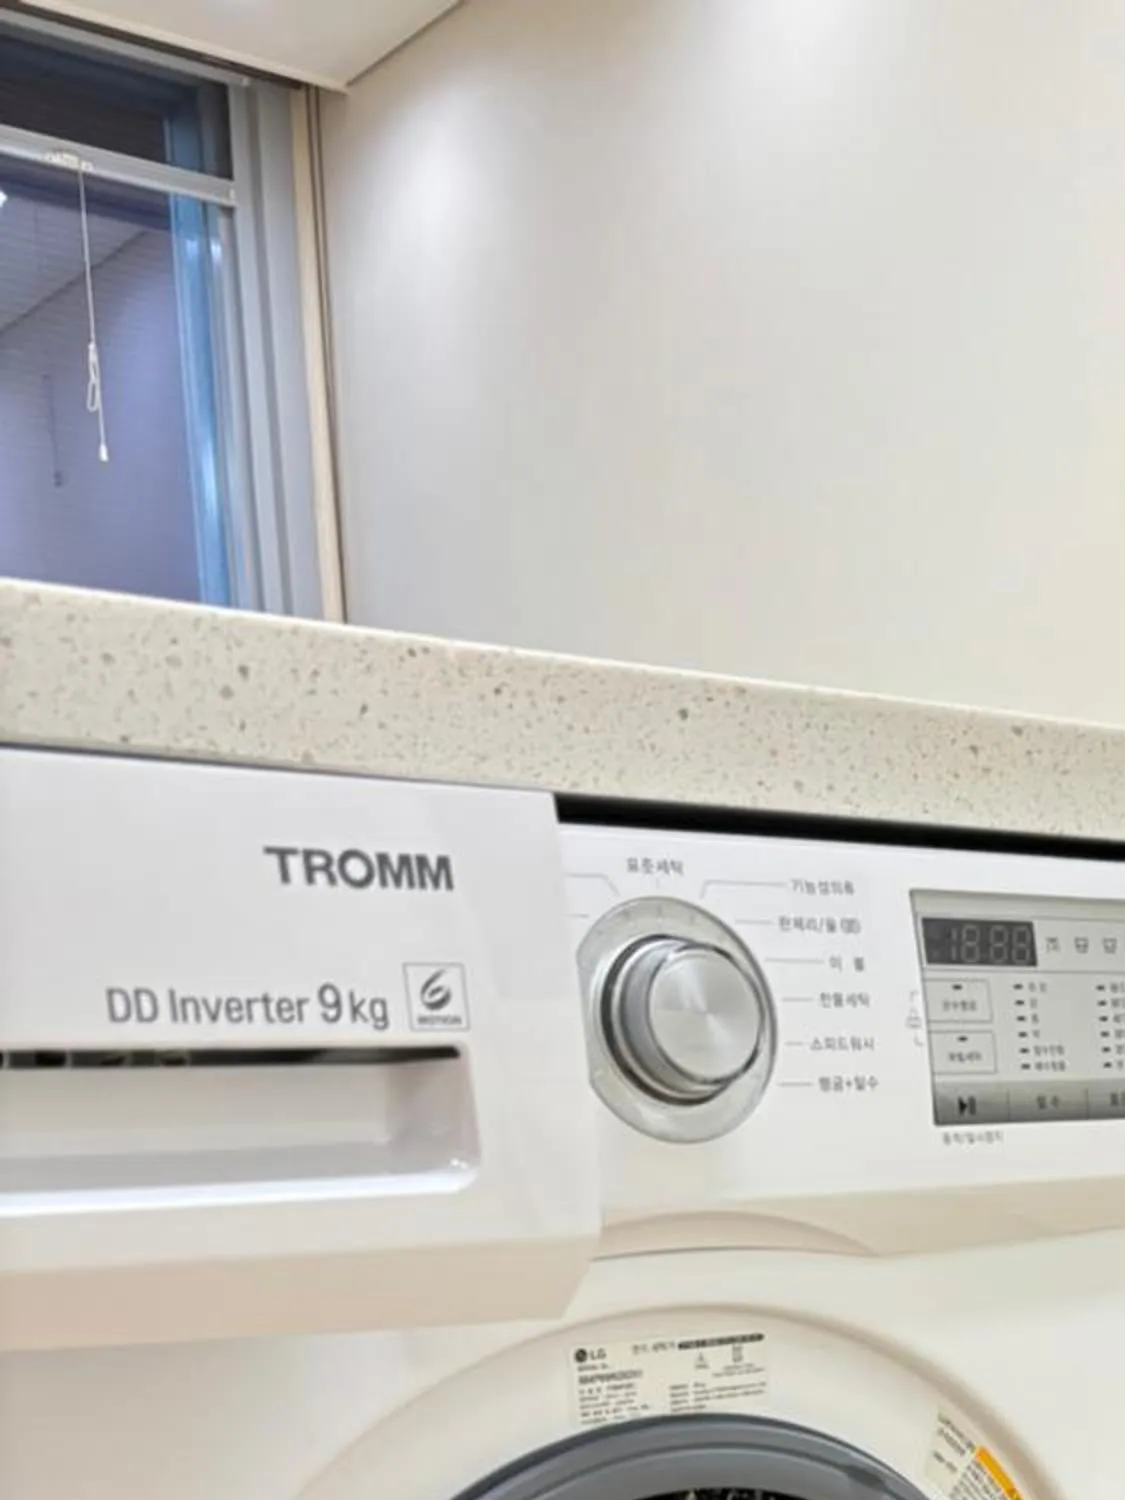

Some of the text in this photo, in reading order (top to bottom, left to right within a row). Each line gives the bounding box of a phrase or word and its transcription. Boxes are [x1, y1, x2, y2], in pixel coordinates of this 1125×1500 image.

[263, 846, 454, 891] TROMM
[106, 987, 159, 1024] DD
[168, 988, 310, 1024] Inverter
[590, 1348, 607, 1362] LG
